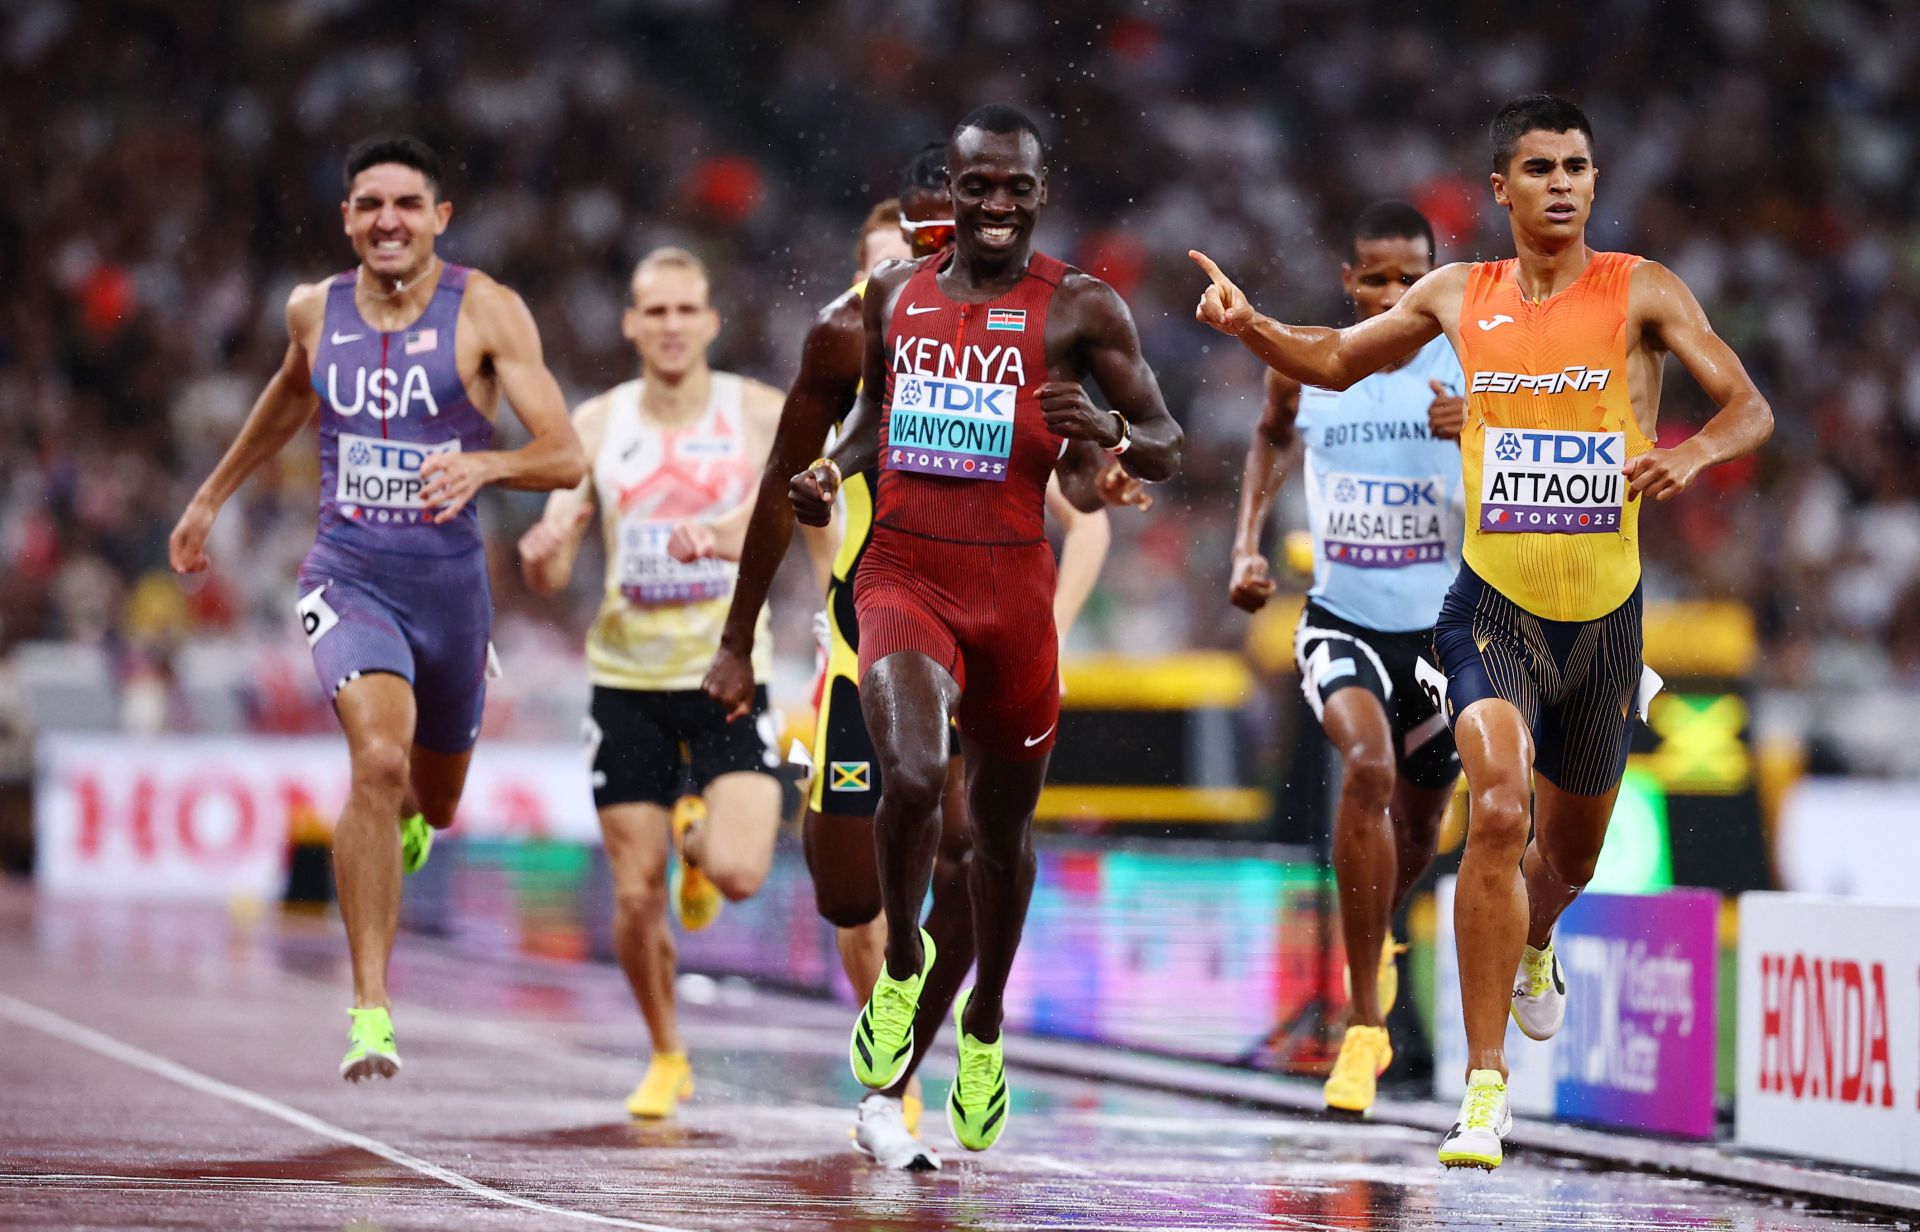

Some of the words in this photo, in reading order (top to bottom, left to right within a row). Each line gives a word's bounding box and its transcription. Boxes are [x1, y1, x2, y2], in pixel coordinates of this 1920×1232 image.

[893, 335, 1025, 386] KENYA
[327, 363, 439, 420] USA
[1471, 365, 1611, 396] ESPAÑA
[924, 381, 1004, 416] TDK
[893, 414, 1007, 453] WANYONYI
[1324, 421, 1438, 448] BOTSWAN
[1522, 433, 1617, 465] TDK
[372, 445, 450, 472] TD
[1358, 480, 1438, 506] TDK
[1489, 472, 1617, 504] ATTAOUI
[1327, 512, 1440, 540] MASALELA
[1760, 952, 1893, 1108] HONDA
